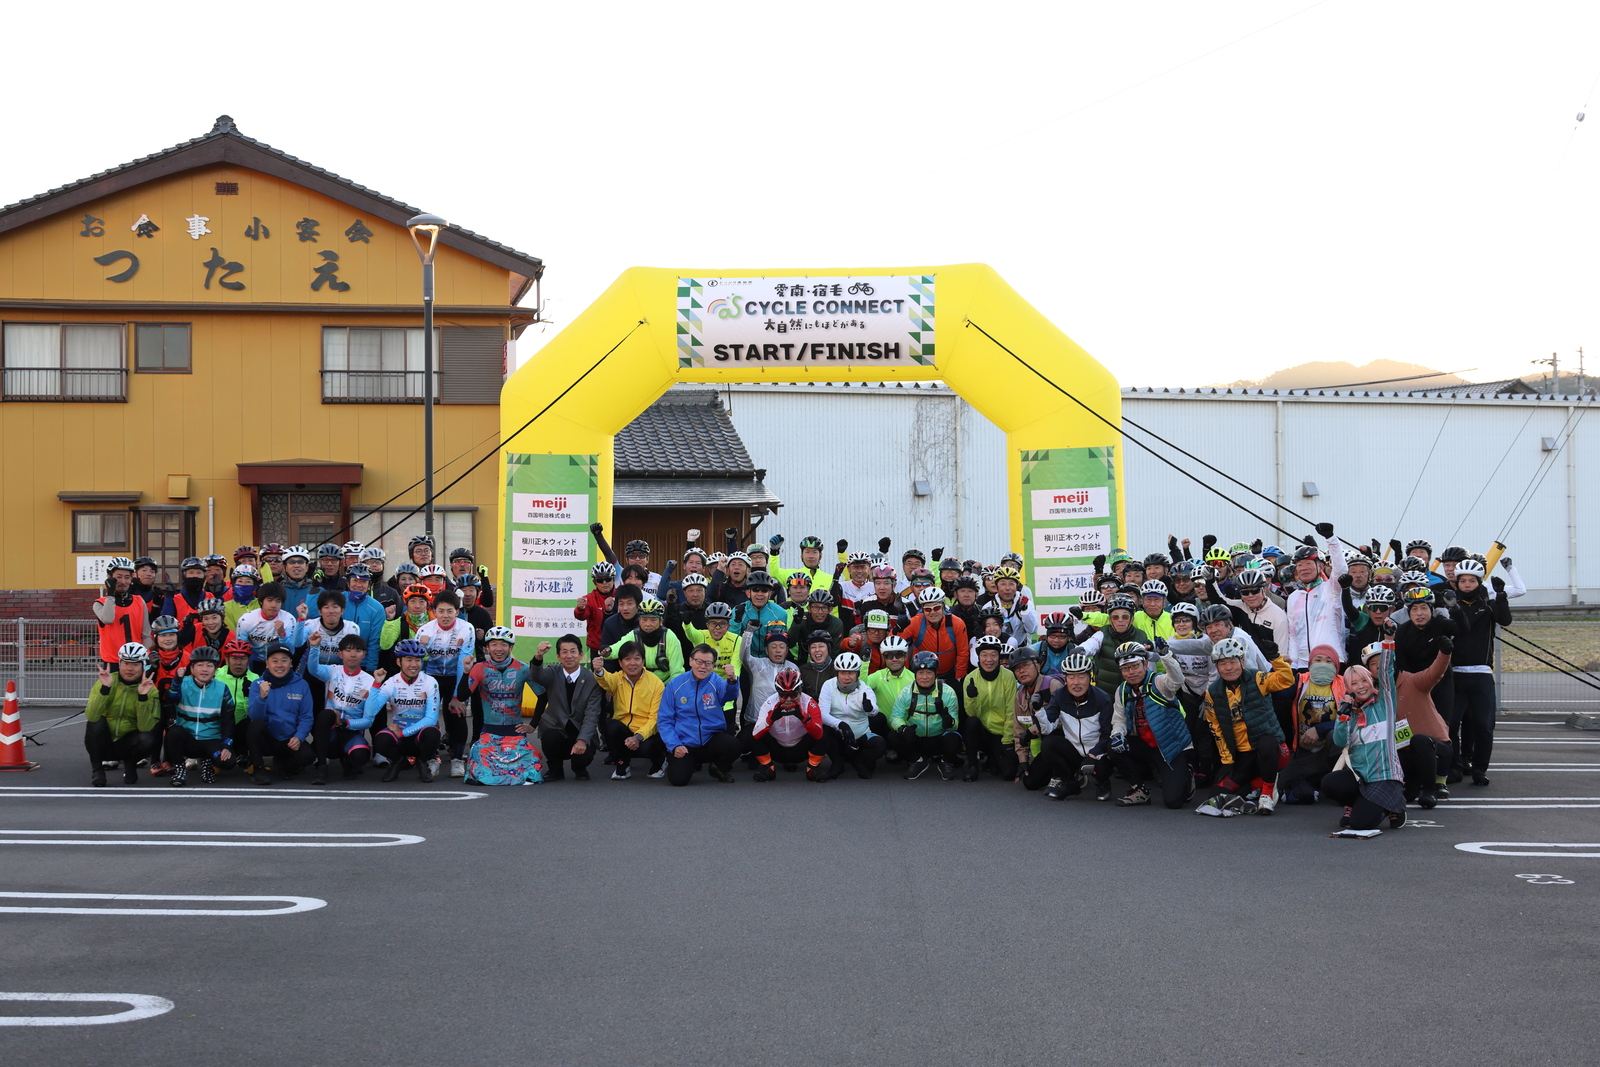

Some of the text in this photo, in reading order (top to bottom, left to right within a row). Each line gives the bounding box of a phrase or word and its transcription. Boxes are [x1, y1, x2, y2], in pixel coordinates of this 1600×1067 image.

[93, 247, 350, 292] つたえ
[745, 299, 905, 315] CYCLE CONNECT
[764, 318, 865, 334] 大自然にもほどがある
[714, 342, 900, 361] START/FINISH
[532, 497, 567, 511] meiji
[1053, 491, 1089, 505] meiji
[1049, 506, 1093, 514] 四国明治株式会社
[522, 548, 577, 557] ファーム合同会社
[1045, 543, 1101, 553] ファーム合同会社
[524, 580, 574, 593] 清水建設
[119, 614, 132, 643] 1
